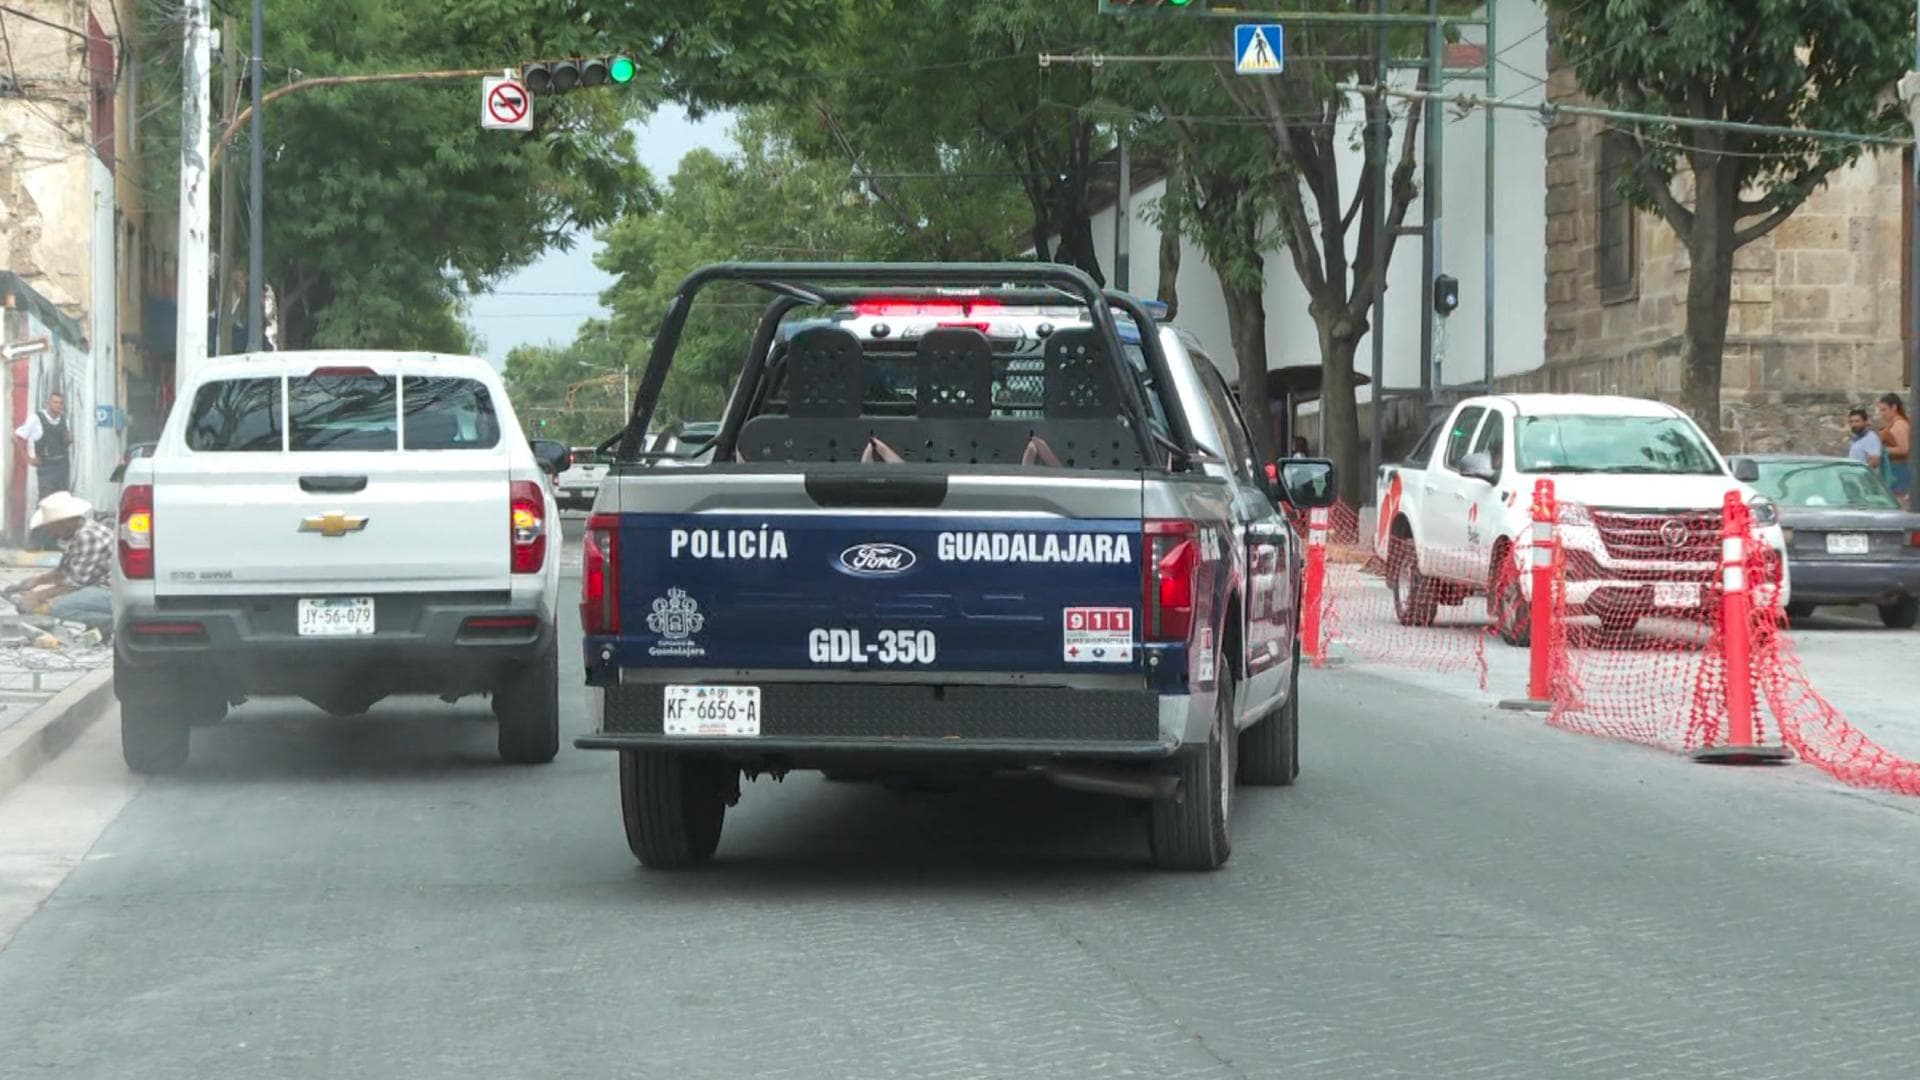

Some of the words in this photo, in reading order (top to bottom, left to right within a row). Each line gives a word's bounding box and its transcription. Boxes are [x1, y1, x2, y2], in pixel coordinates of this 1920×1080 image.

[671, 523, 788, 559] POLICÍA
[937, 532, 1131, 563] GUADALAJARA
[853, 547, 903, 568] Ford
[303, 607, 371, 625] JY-56-079
[1070, 613, 1124, 630] 911
[808, 628, 936, 664] GDL-350
[667, 698, 756, 721] KF-6656-A
